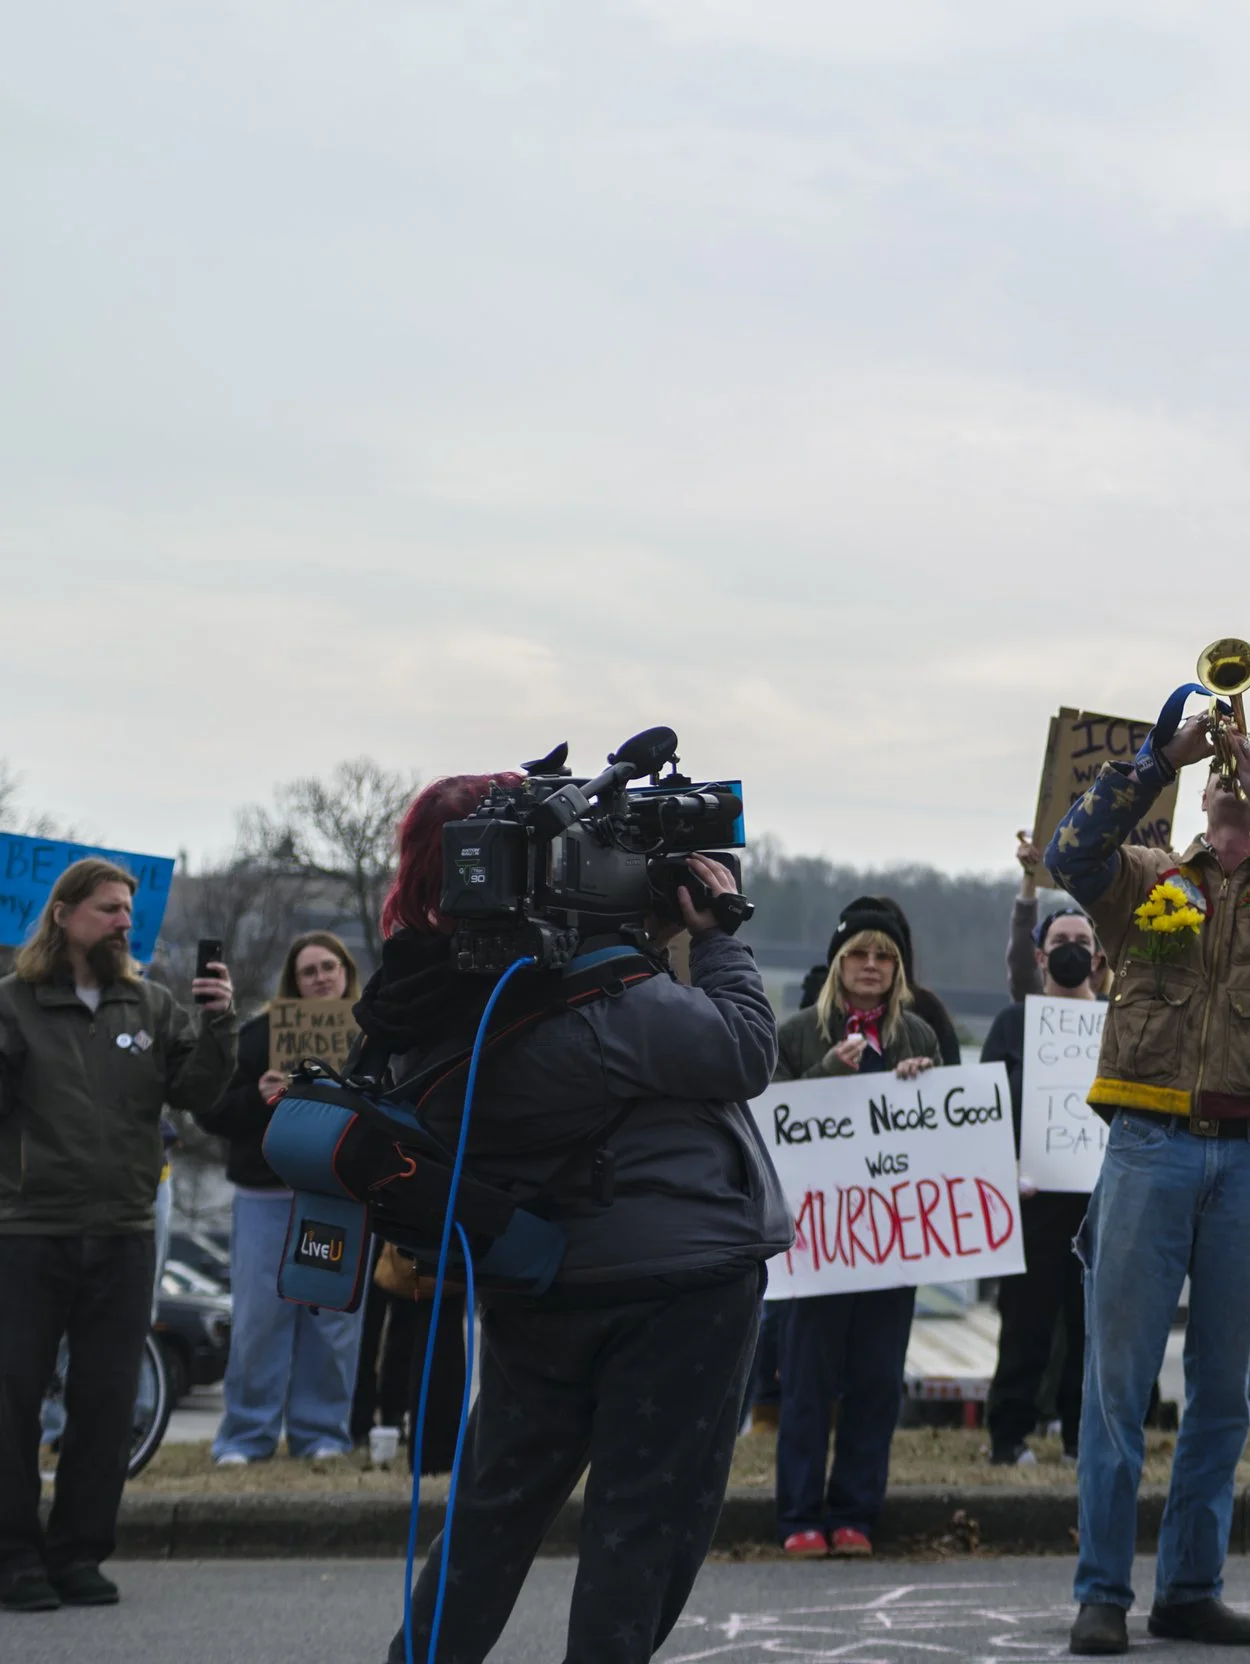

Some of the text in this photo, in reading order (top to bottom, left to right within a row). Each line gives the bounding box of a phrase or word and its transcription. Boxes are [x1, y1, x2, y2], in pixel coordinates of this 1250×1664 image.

[470, 874, 486, 883] 90
[773, 1083, 1003, 1146] Renee Nicole Good
[1046, 1092, 1100, 1121] IC
[785, 1173, 1015, 1276] MURDERED
[301, 1229, 343, 1262] LiveU
